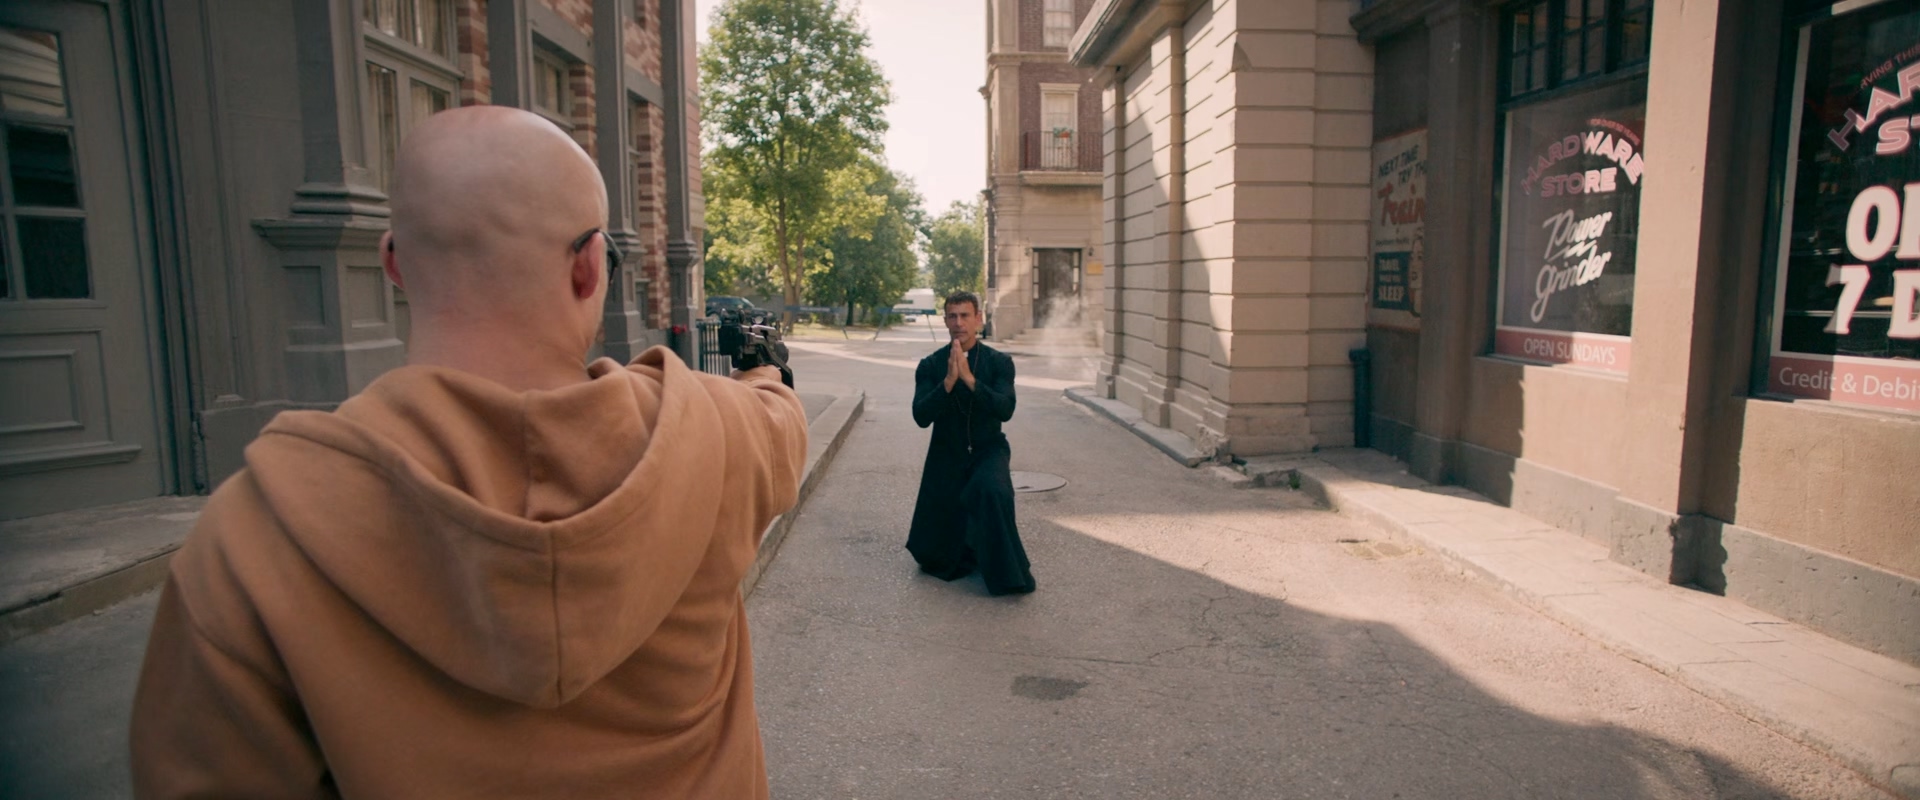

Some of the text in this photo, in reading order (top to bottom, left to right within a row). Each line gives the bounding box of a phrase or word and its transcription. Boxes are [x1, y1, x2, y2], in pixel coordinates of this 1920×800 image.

[1521, 131, 1644, 195] HARDWARE
[1541, 167, 1617, 197] STORE
[1542, 209, 1612, 259] Power
[1378, 285, 1405, 303] SLEEP
[1823, 263, 1871, 334] 7
[1524, 338, 1616, 365] OPEN SUNDAYS
[1779, 366, 1920, 401] Credit & Debi
